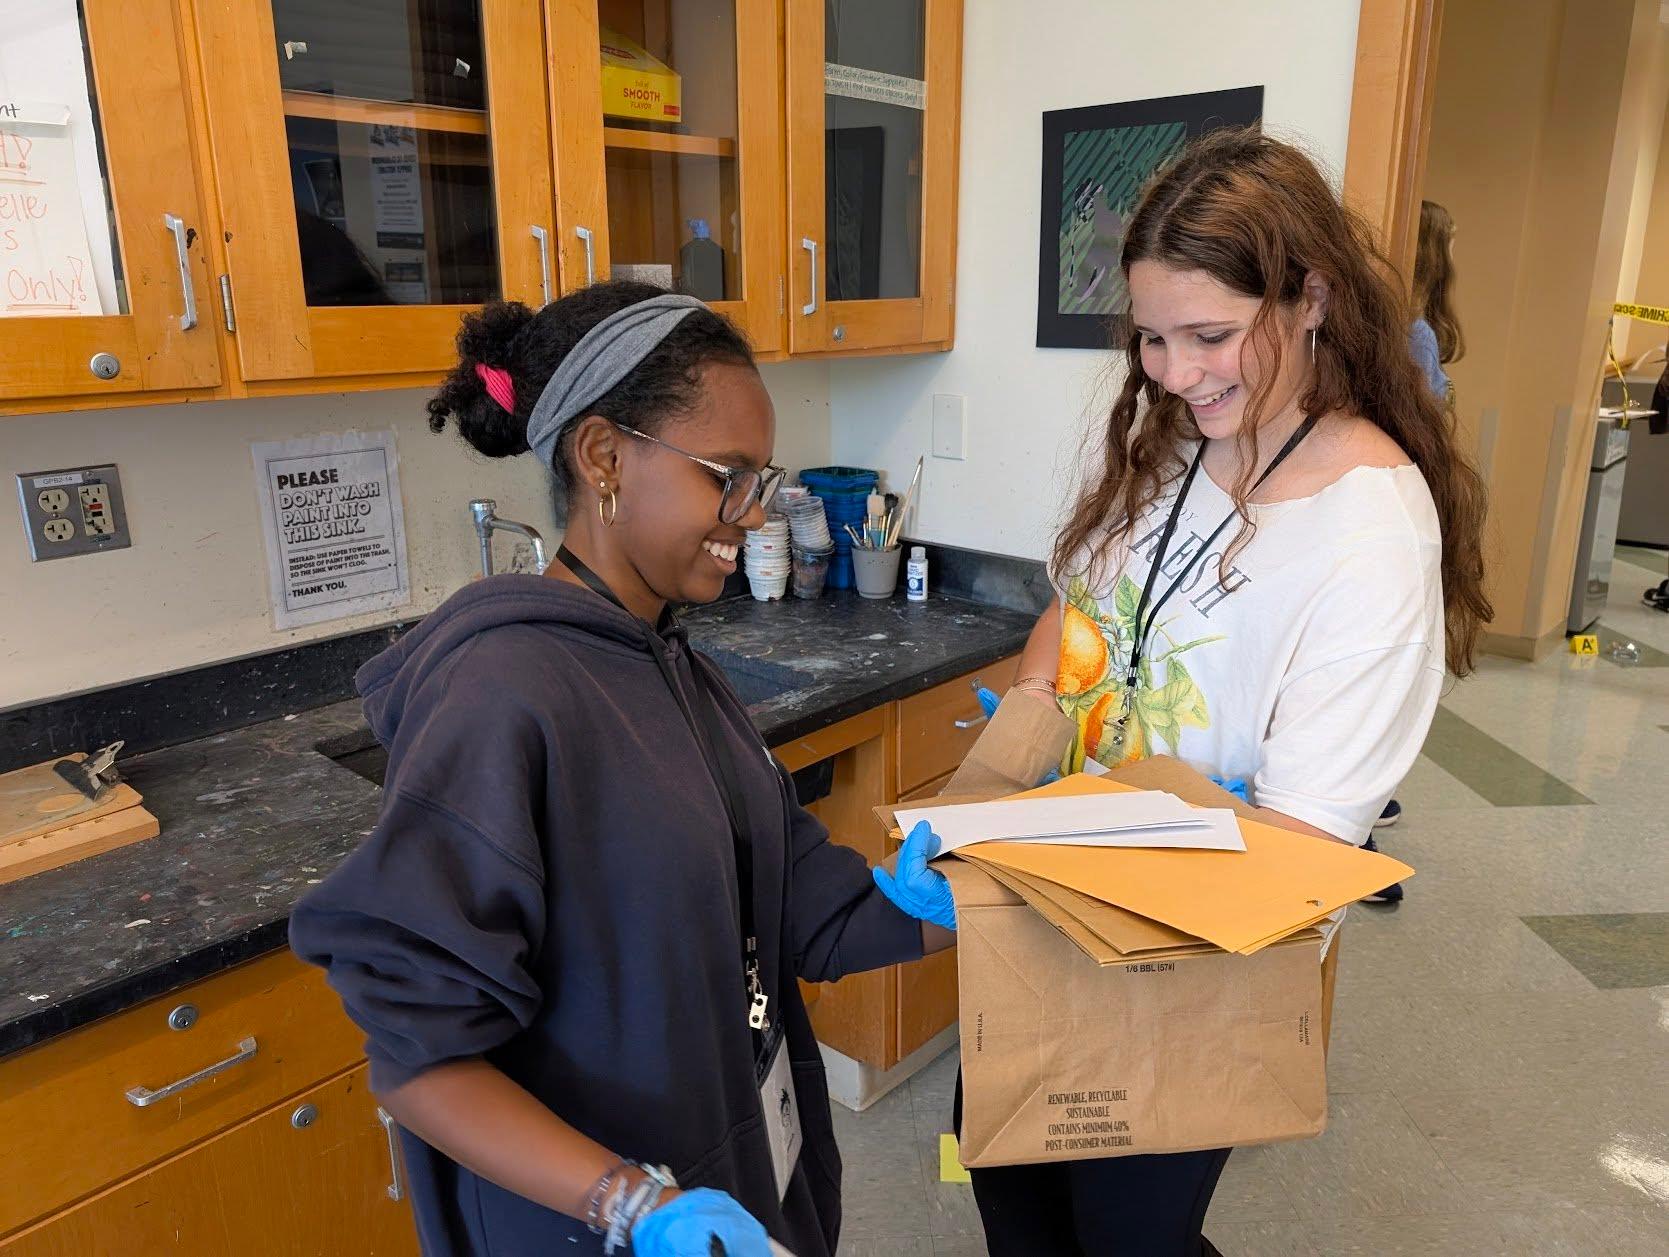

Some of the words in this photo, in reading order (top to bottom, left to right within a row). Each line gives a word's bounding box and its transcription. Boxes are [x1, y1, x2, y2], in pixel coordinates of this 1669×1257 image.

[623, 87, 661, 102] SMOOTH
[631, 101, 653, 110] FLAVOR
[7, 255, 86, 310] Only!
[277, 468, 338, 490] PLEASE
[280, 487, 332, 510] DON'T
[334, 482, 380, 502] WASH
[282, 505, 331, 527] PAINT
[332, 500, 371, 520] INTO
[284, 524, 321, 544] THIS
[322, 518, 365, 539] SINK.
[288, 555, 316, 565] INSTEAD:
[316, 552, 328, 560] USE
[328, 548, 348, 558] PAPER
[348, 544, 372, 554] TOWELS
[372, 543, 381, 551] TO
[289, 561, 316, 572] DISPOSE
[325, 557, 344, 566] PAINT
[344, 553, 359, 561] INTO
[360, 551, 370, 559] THE
[300, 569, 312, 577] THE
[312, 566, 326, 575] SINK
[327, 562, 348, 572] WON'T
[348, 559, 368, 568] CLOG.
[292, 584, 324, 598] THANK
[325, 580, 348, 591] YOU.
[1582, 638, 1593, 652] A
[1139, 964, 1156, 973] BBL
[1088, 1089, 1128, 1103] RECYCLABLE
[1066, 1105, 1111, 1119] SUSTAINABLE
[1048, 1122, 1081, 1136] CONTAINS
[1081, 1121, 1113, 1134] MINIMUM
[1113, 1120, 1130, 1133] 40%
[1045, 1137, 1100, 1152] POST-CONSUMER
[1100, 1135, 1133, 1148] MATERIAL
